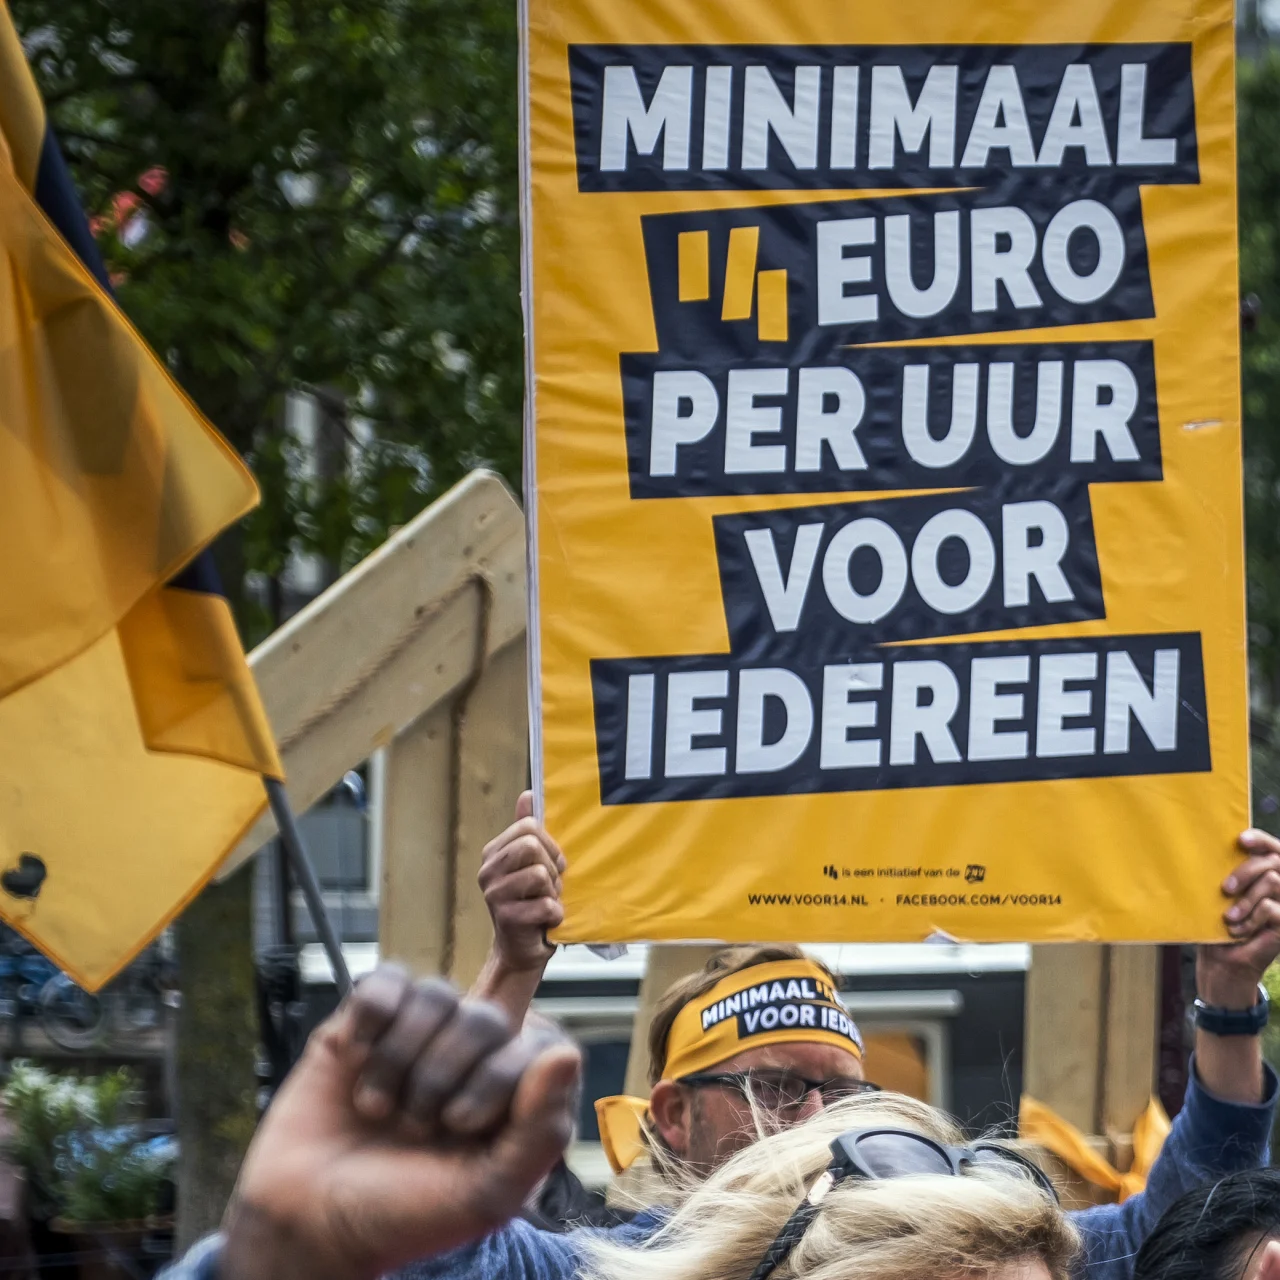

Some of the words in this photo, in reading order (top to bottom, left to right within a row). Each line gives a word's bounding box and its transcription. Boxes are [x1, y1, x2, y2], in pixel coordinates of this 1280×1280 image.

[600, 63, 1178, 172] MINIMAAL
[816, 199, 1126, 326] EURO
[649, 365, 869, 477] PER
[900, 358, 1140, 468] UUR
[744, 499, 1075, 633] VOOR
[624, 648, 1181, 781] IEDEREEN
[748, 894, 868, 906] WWW.VOOR14.NL
[896, 893, 1062, 906] FACEBOOK.COM/VOOR14
[842, 867, 850, 877] is
[853, 868, 874, 877] een
[877, 866, 921, 877] initiatief
[924, 868, 943, 877] van
[946, 867, 960, 877] de
[702, 979, 815, 1029] MINIMAAL
[744, 1003, 815, 1033] VOOR
